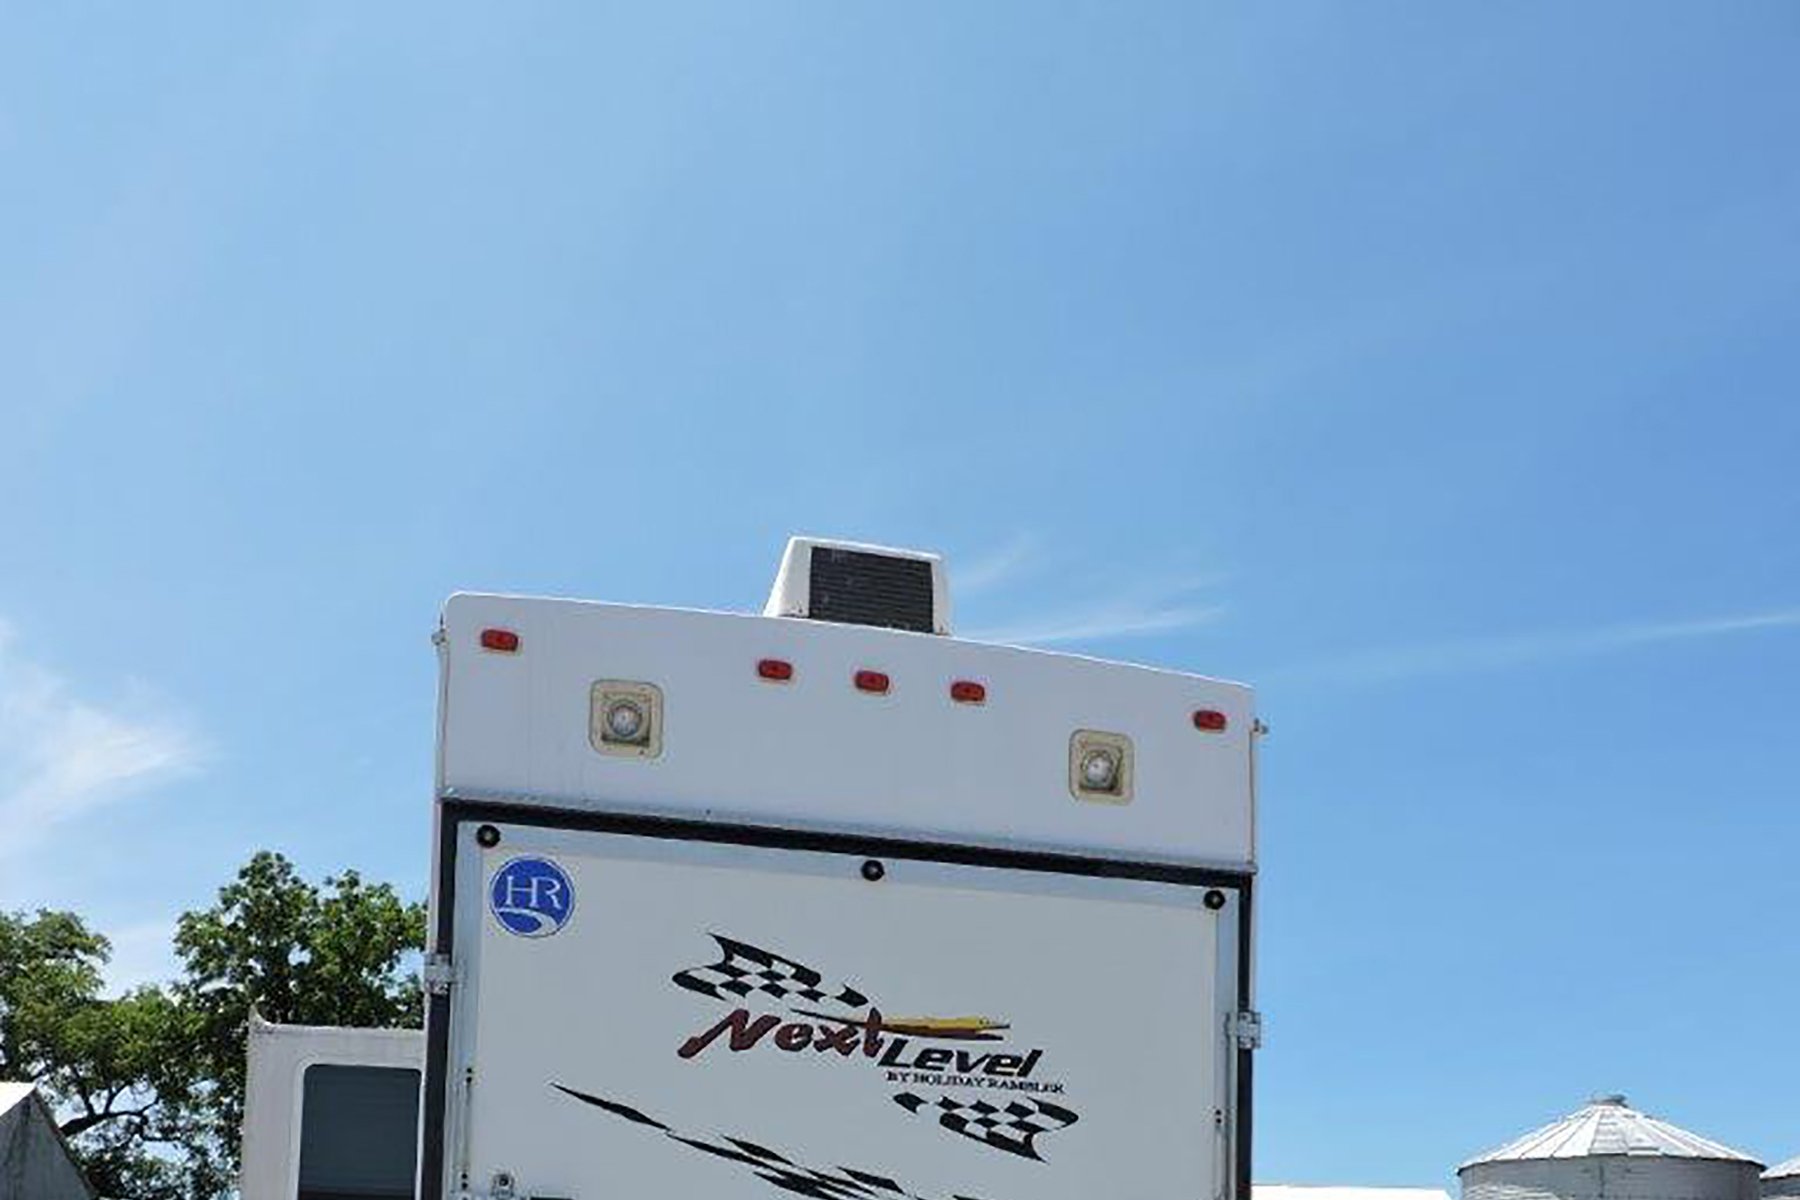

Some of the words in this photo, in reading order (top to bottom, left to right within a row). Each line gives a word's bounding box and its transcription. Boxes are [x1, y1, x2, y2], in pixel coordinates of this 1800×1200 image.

[505, 875, 562, 909] HR
[677, 1007, 885, 1059] Next
[877, 1037, 1043, 1078] Level
[887, 1071, 911, 1083] BY
[914, 1073, 985, 1088] HOLIDAY
[987, 1078, 1065, 1094] RAMBLER
